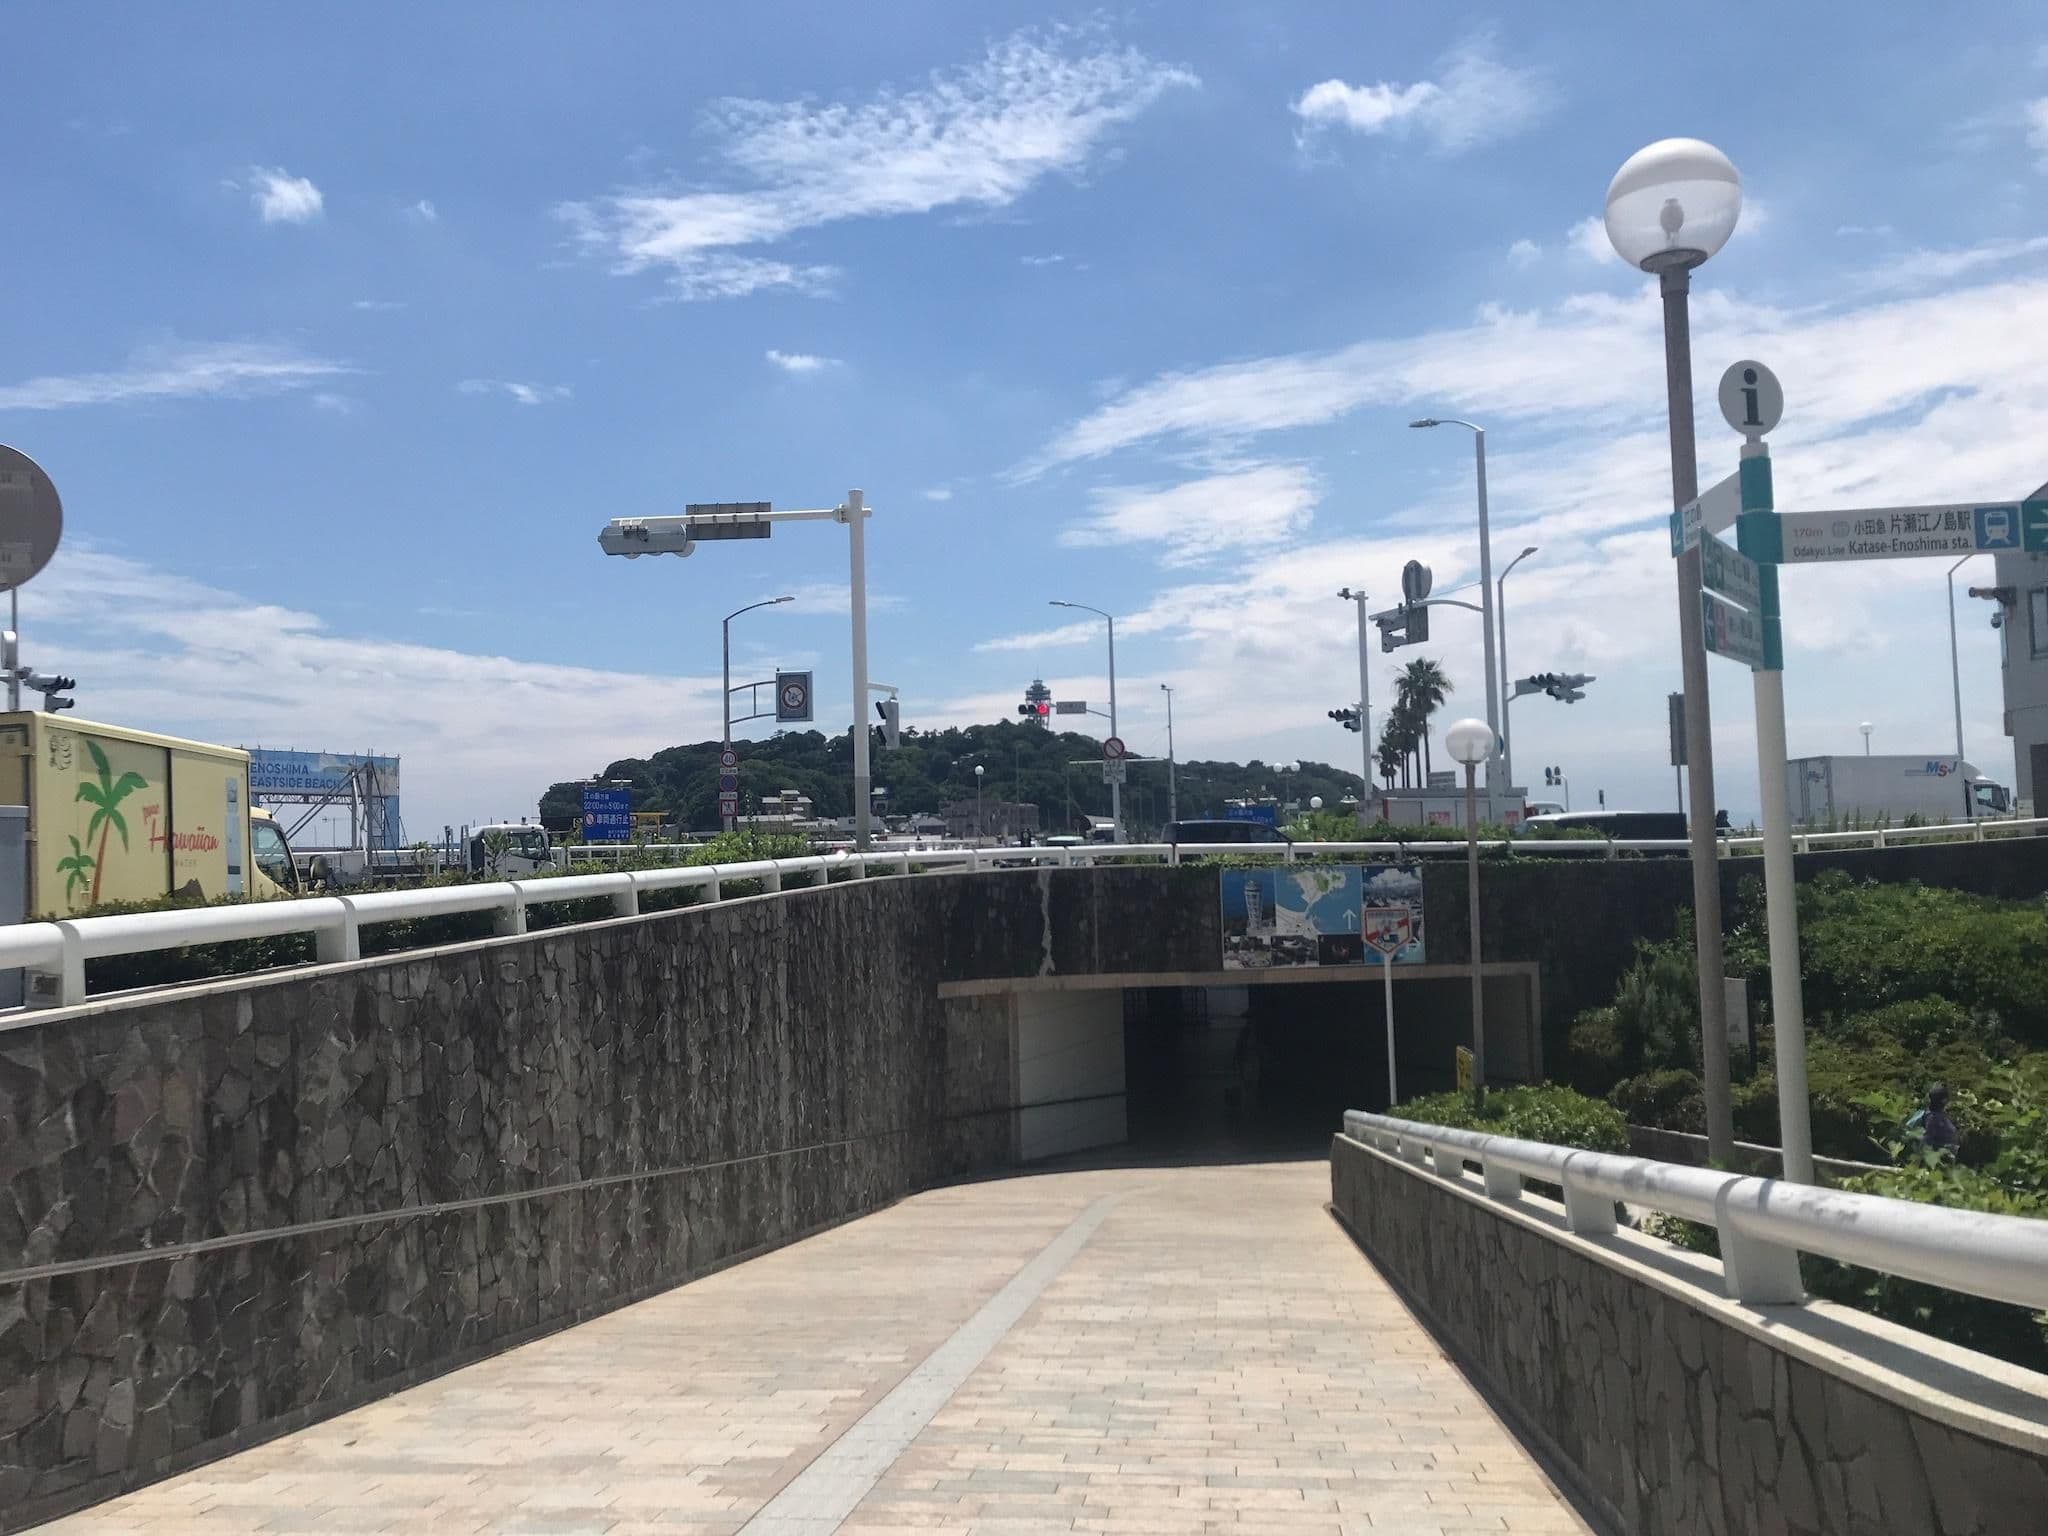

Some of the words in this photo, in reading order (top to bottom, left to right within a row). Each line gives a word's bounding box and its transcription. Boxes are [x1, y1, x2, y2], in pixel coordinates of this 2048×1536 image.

[1854, 518, 1887, 536] 小田急
[1890, 510, 1972, 534] 片瀬江ノ島駅
[1793, 545, 1825, 560] Odakyu
[1849, 536, 1949, 556] Katase-Enoshima
[1951, 536, 1973, 549] sta.
[724, 754, 734, 764] 40
[250, 762, 309, 775] ENOSHIMA
[1926, 761, 1958, 778] MSJ
[250, 776, 305, 789] EASTSIDE
[306, 777, 340, 789] BEACH
[149, 815, 220, 854] Hawaiian
